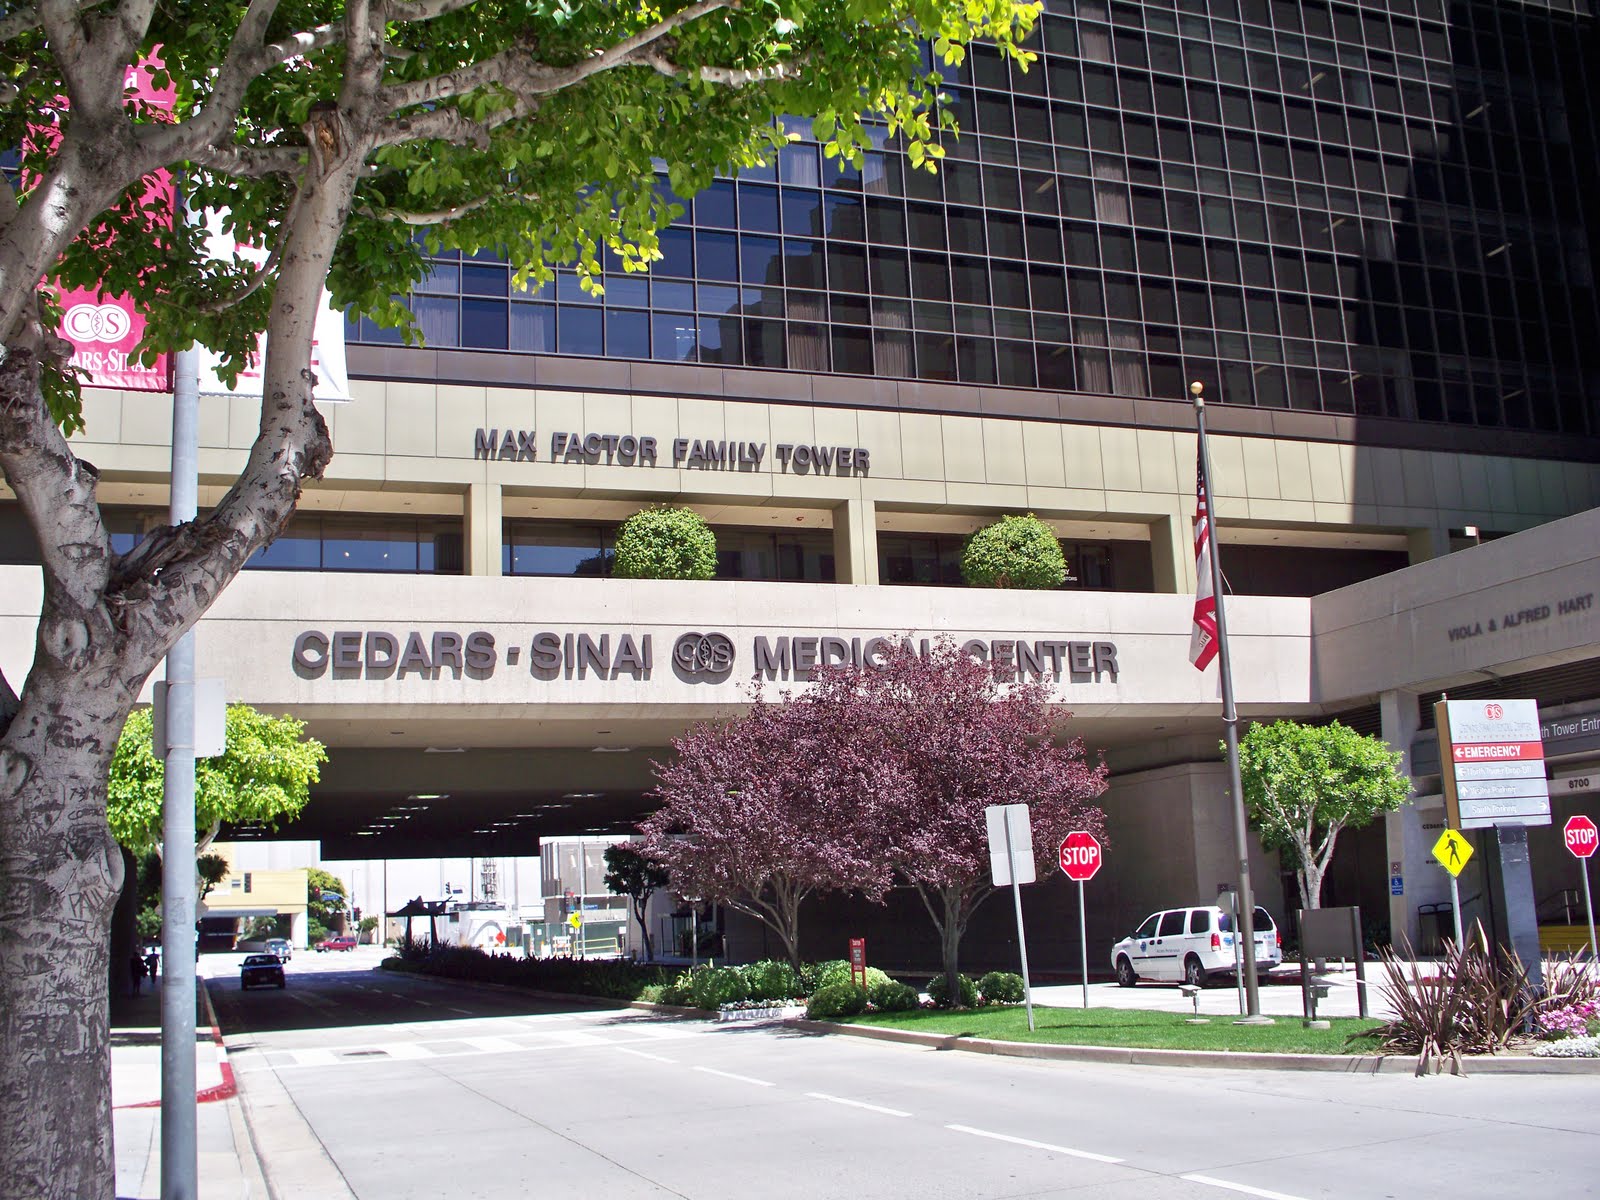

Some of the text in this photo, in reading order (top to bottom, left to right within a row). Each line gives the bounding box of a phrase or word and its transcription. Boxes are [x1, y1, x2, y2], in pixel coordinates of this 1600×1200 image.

[475, 428, 870, 469] MAX FACTOR FAMILY TOWER
[1448, 593, 1594, 642] VIOLA & ALFRED HART
[1551, 723, 1579, 737] Tower
[1464, 745, 1521, 758] EMERGENCY
[1568, 778, 1590, 789] 8700
[1472, 804, 1517, 814] South Parking
[1567, 828, 1595, 845] STOP
[1062, 846, 1098, 866] STOP
